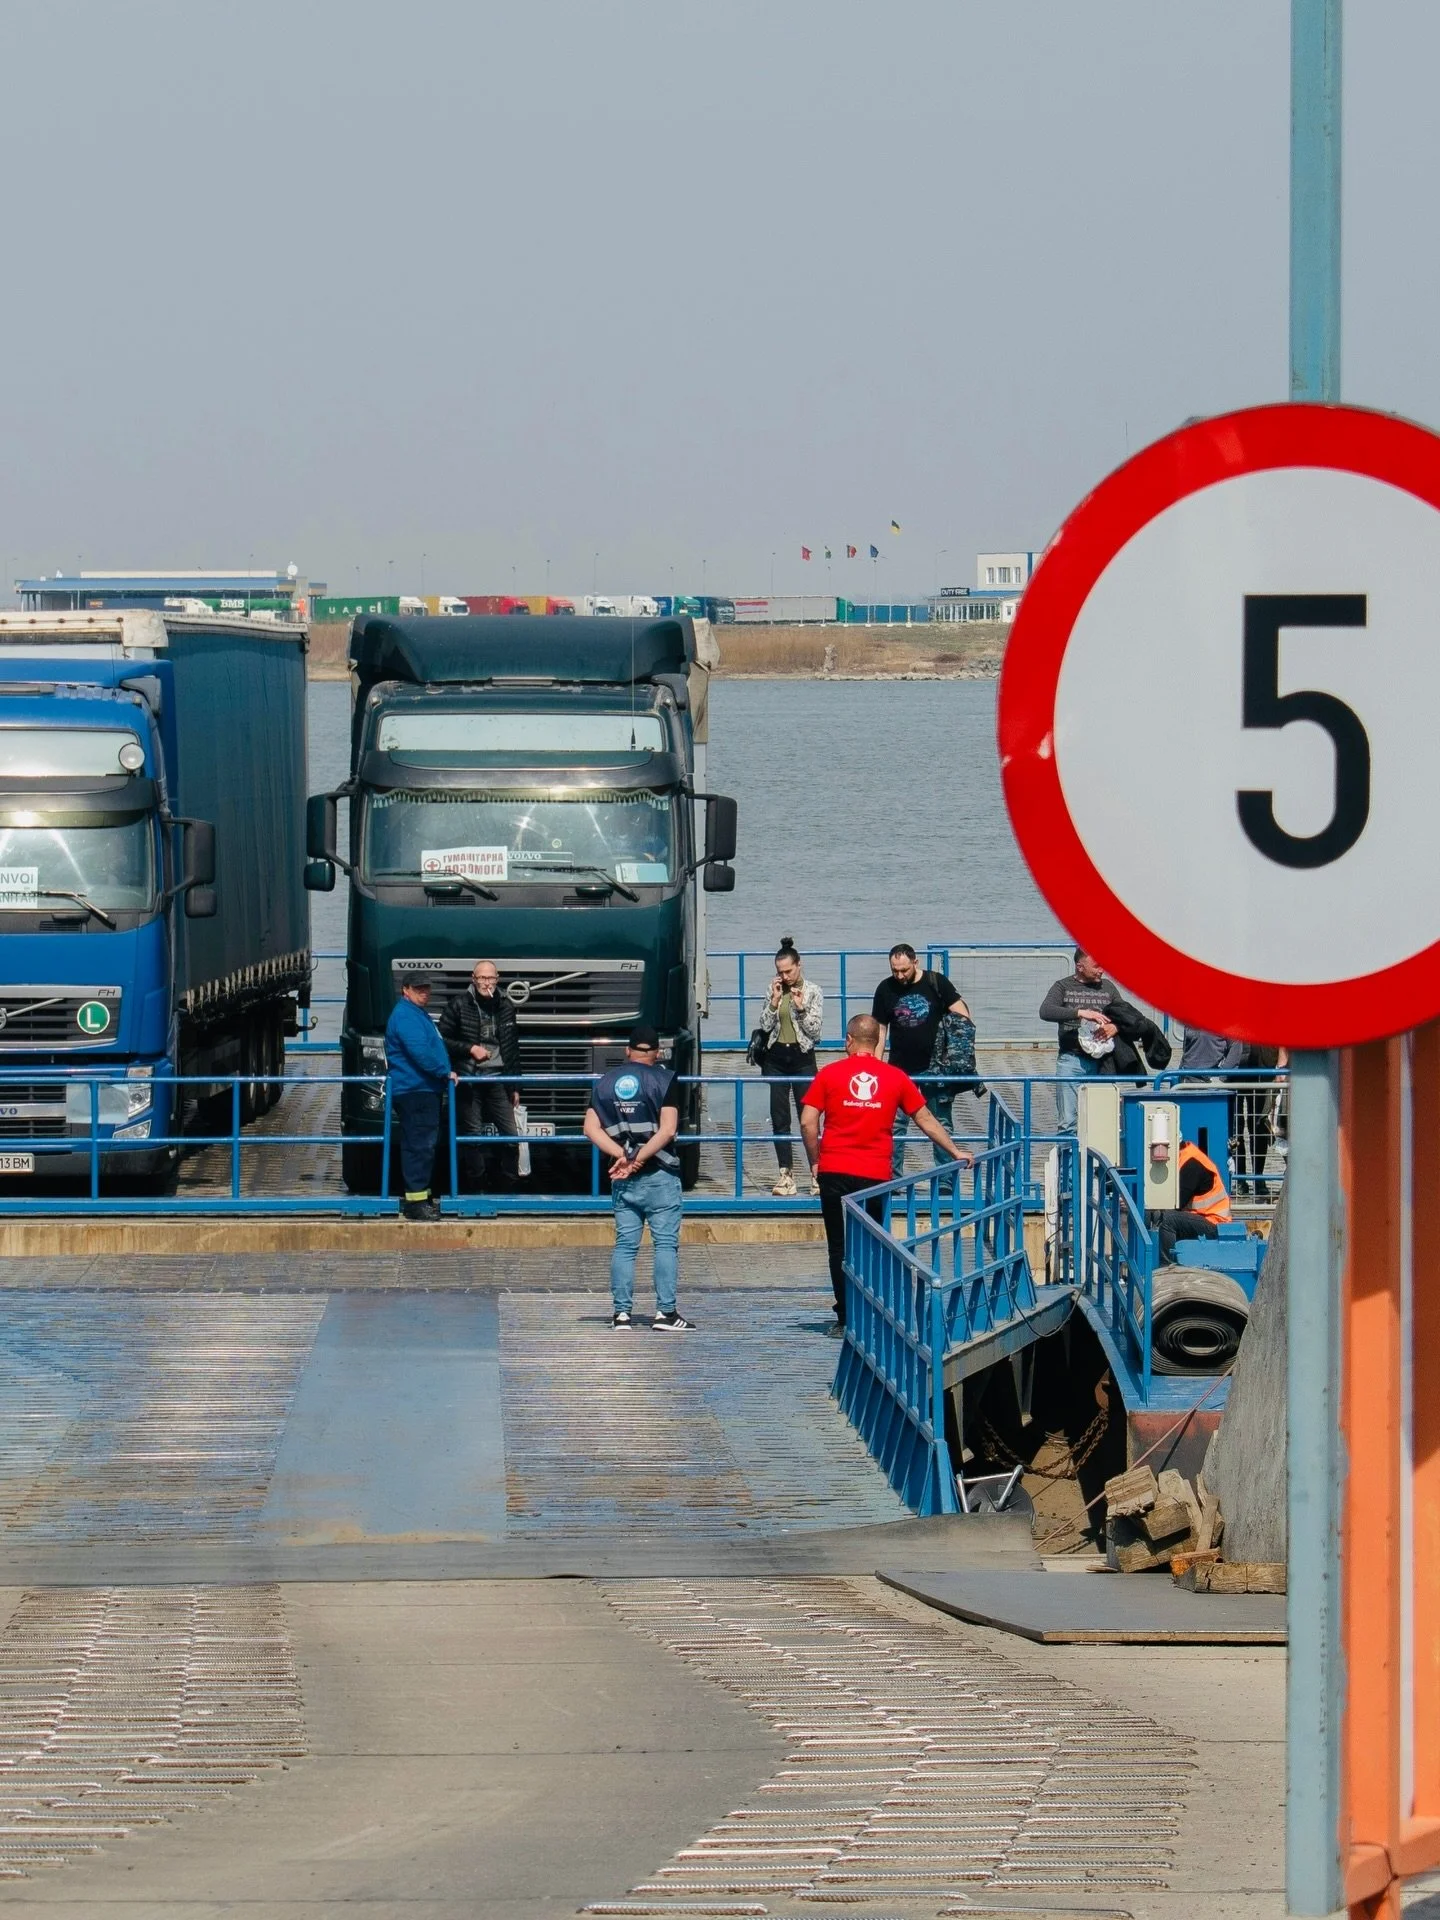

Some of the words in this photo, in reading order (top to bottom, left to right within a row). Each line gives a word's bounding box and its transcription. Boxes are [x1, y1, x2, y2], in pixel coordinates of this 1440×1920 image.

[1237, 594, 1371, 870] 5
[443, 852, 504, 863] ГУМАНІТАРНА
[507, 852, 542, 860] VOLVO
[87, 1007, 101, 1028] L
[13, 1157, 30, 1169] BM
